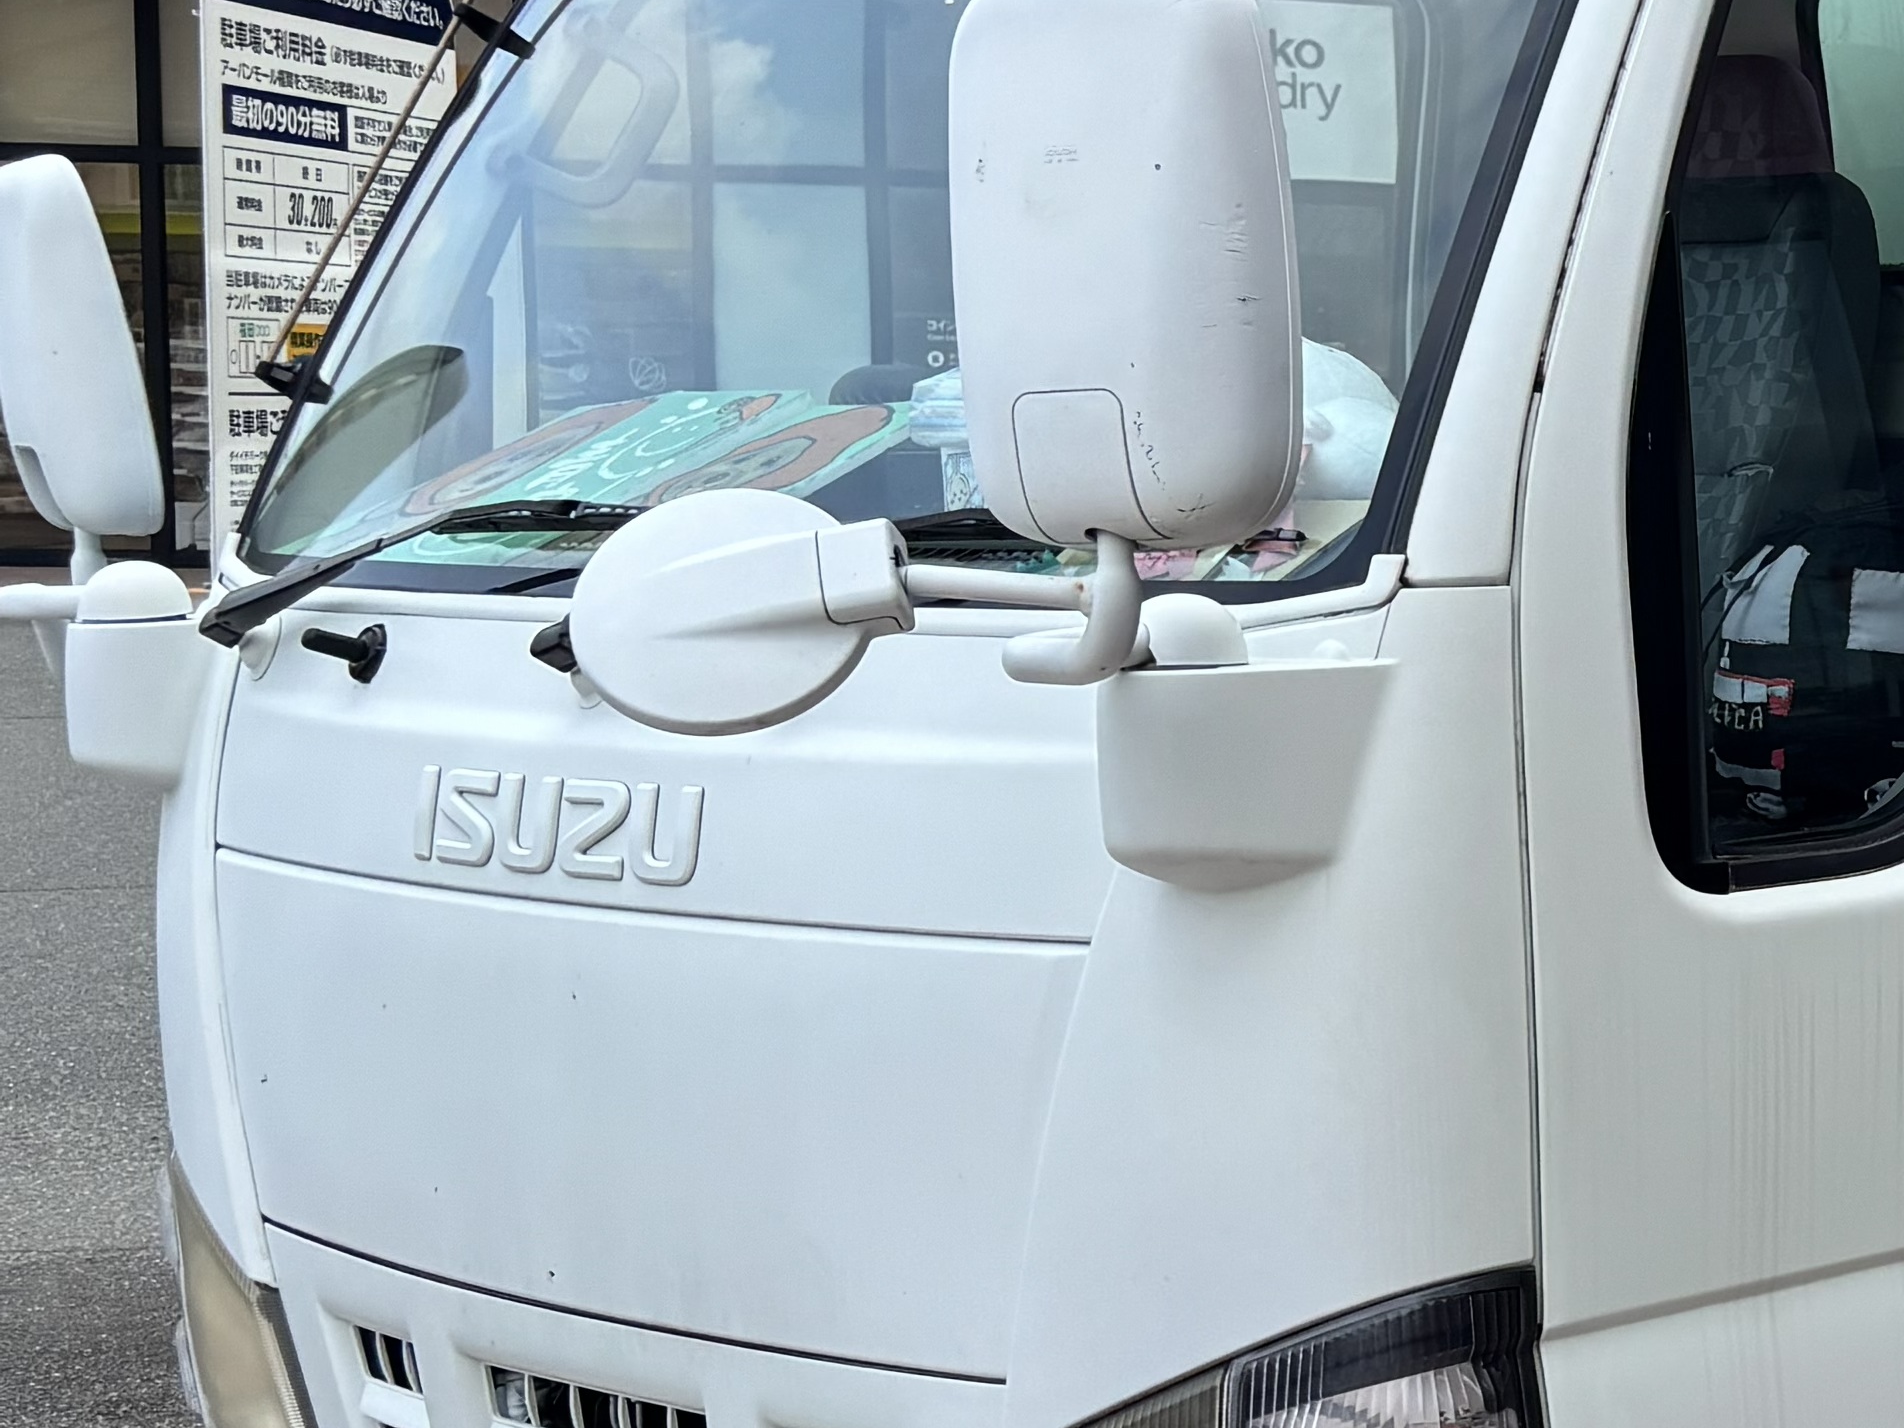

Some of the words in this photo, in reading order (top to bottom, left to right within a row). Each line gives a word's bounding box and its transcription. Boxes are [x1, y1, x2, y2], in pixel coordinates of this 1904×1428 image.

[220, 17, 327, 67] 駐車場ご利用料金
[231, 94, 341, 143] 最初の90分無料
[413, 763, 706, 887] ISUZU
